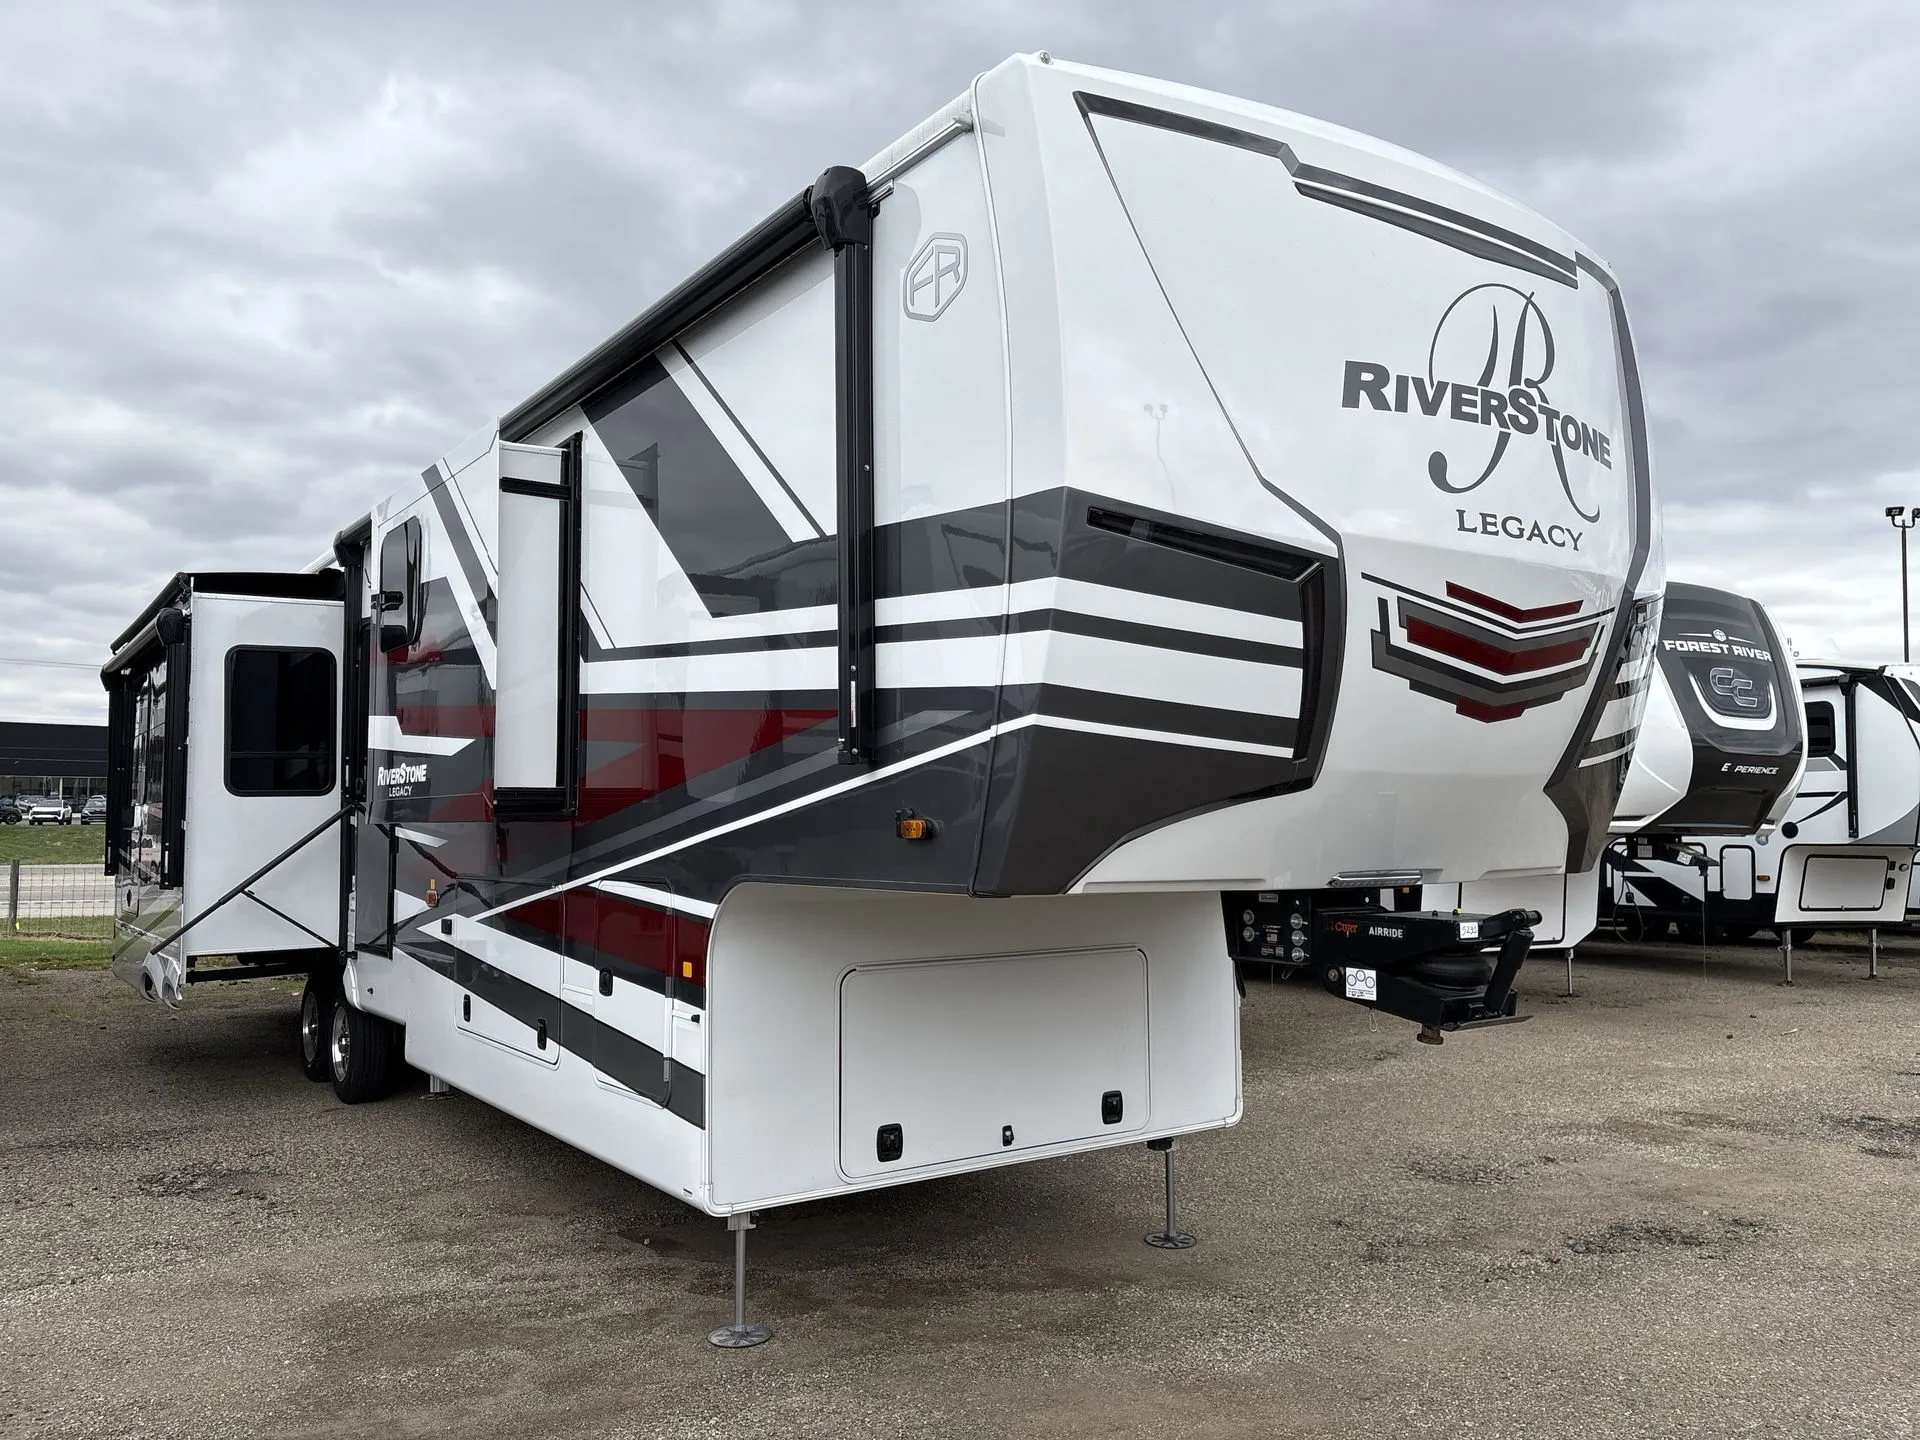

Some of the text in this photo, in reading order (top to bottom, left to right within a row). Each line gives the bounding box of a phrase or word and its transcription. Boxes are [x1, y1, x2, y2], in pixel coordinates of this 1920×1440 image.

[1456, 508, 1583, 551] LEGACY
[1662, 639, 1773, 662] FOREST RIVER
[388, 785, 412, 797] LEGACY
[1335, 922, 1403, 938] CURT AIRRIDE
